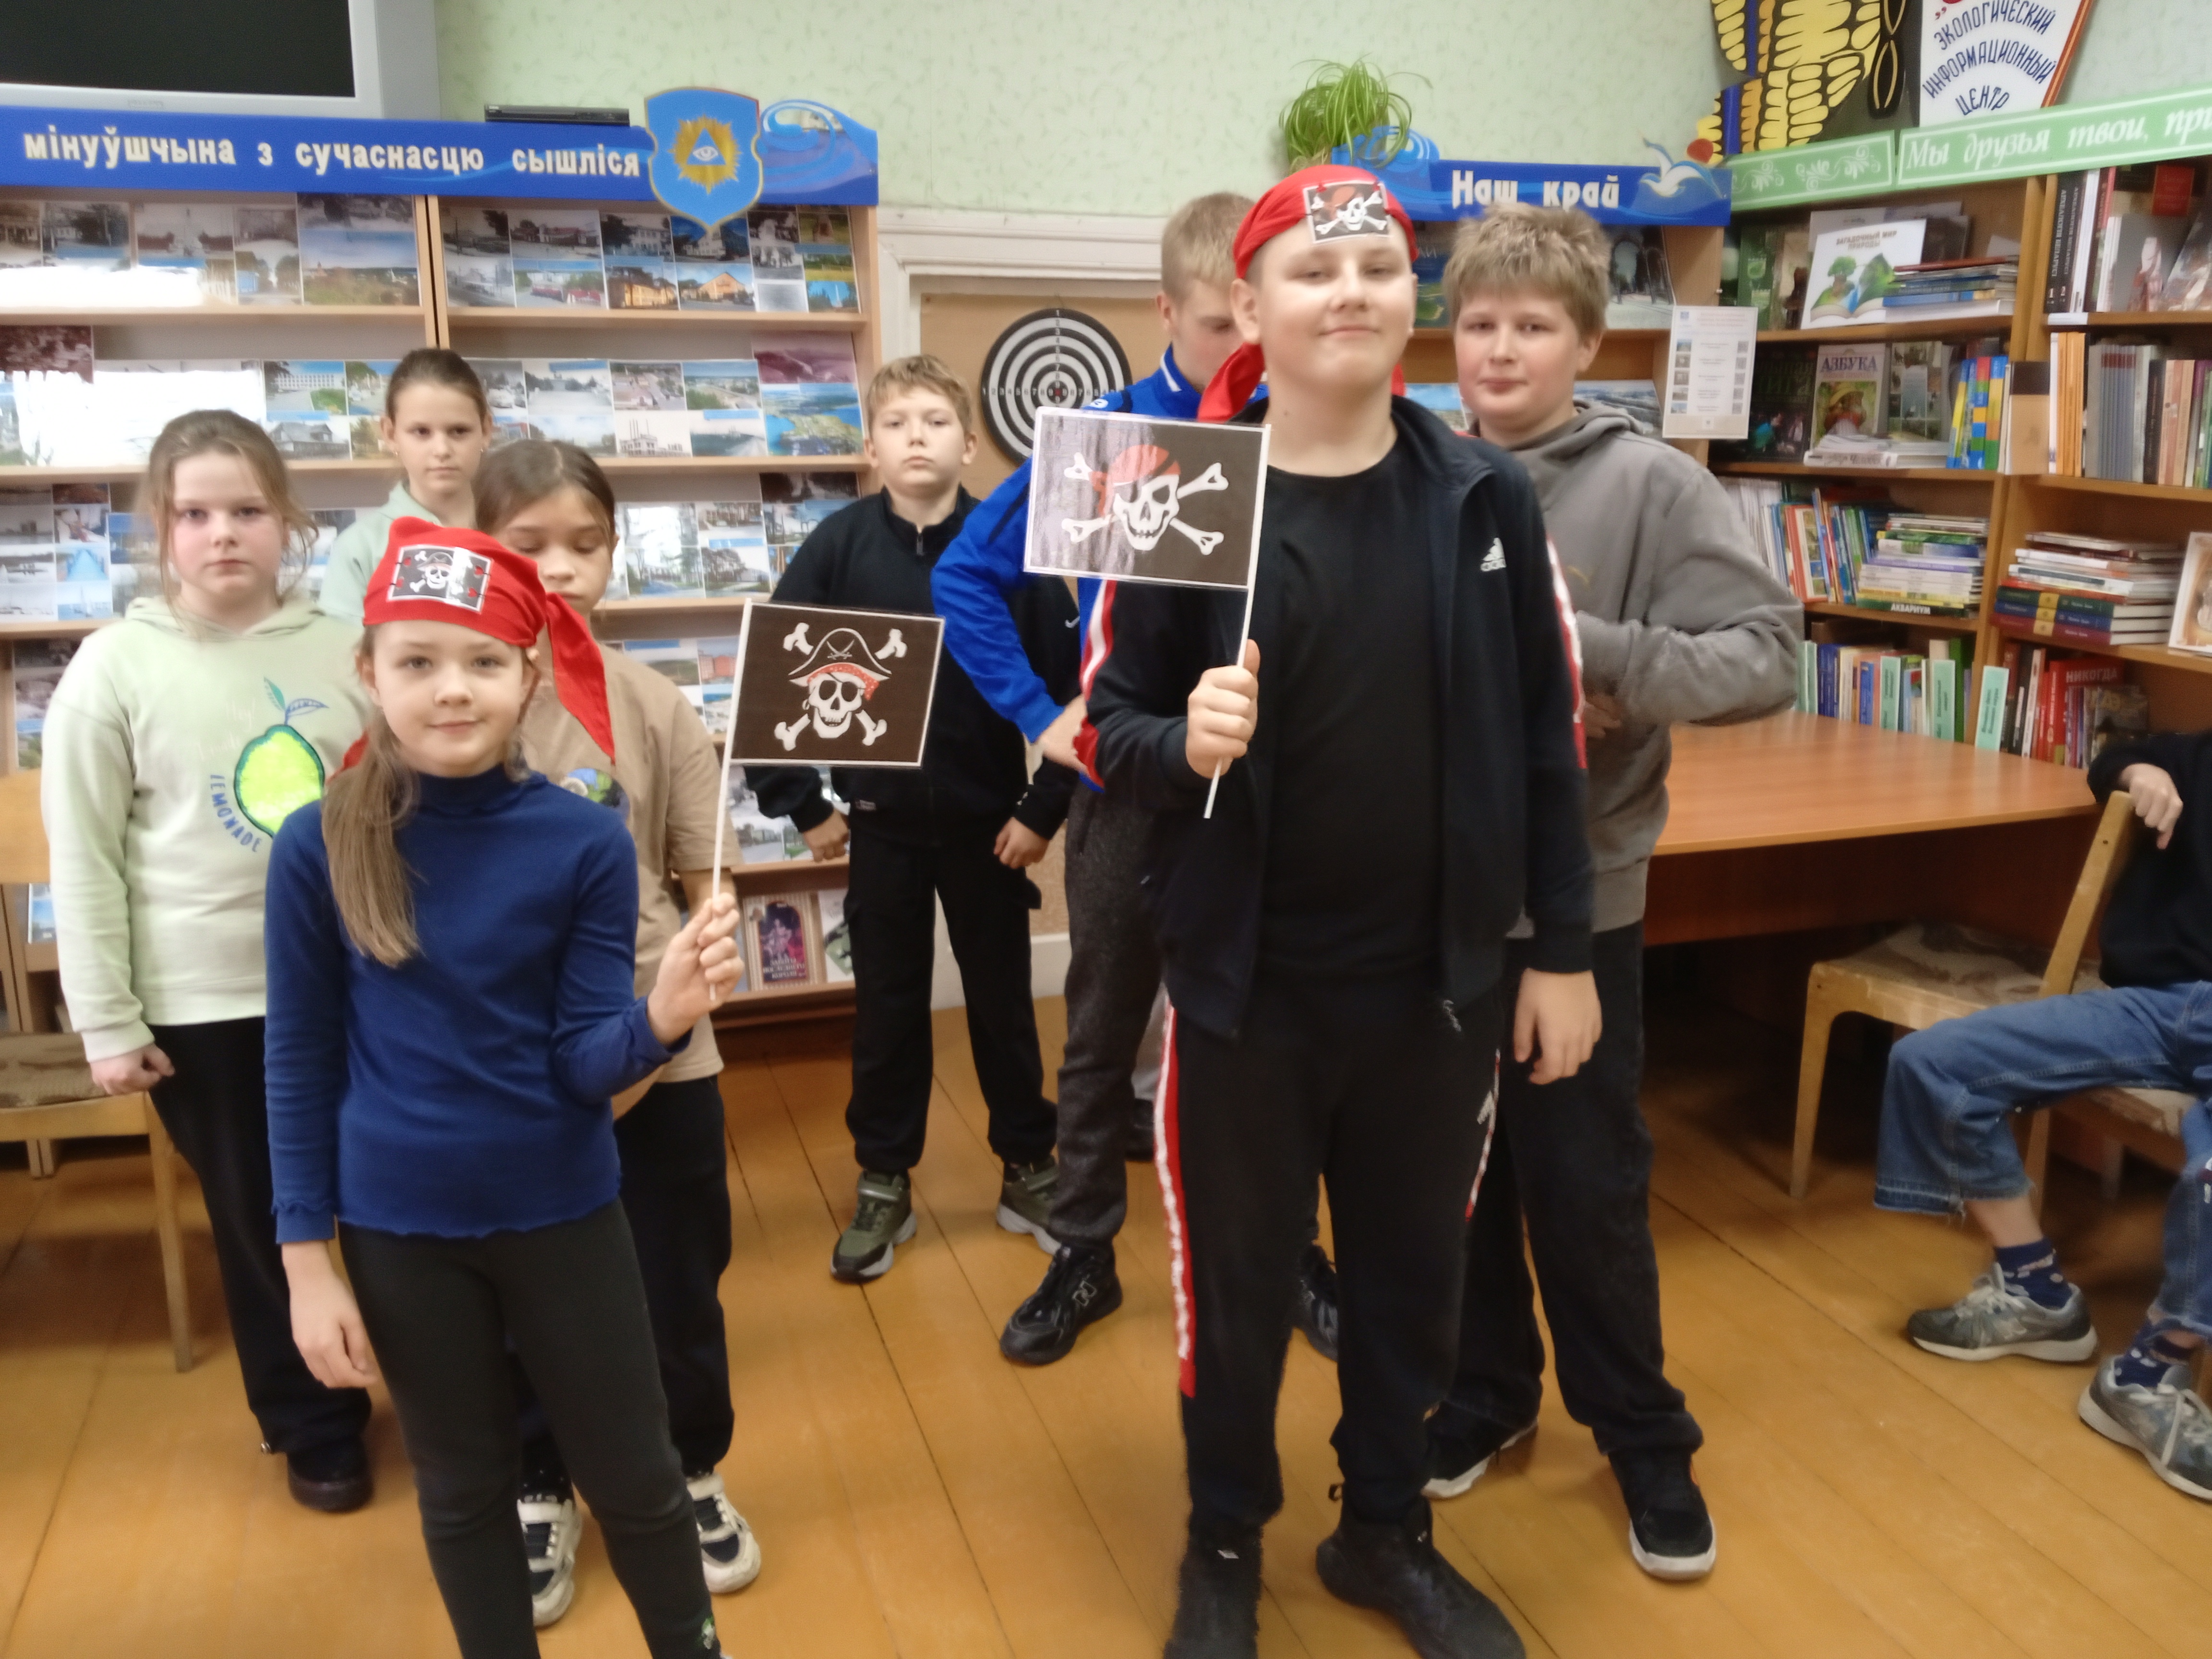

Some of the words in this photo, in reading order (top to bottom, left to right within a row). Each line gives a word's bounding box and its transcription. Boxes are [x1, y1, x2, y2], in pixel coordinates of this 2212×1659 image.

[1934, 0, 2056, 50] ЭКОЛОГИЧЕСКИЙ
[1922, 39, 2057, 98] ИНФОРМАЦИОННЫЙ
[1955, 85, 2010, 116] ЦЕНТР
[24, 124, 236, 169] мінуўшчына
[257, 142, 273, 166] з
[295, 142, 484, 175] сучаснасцю
[512, 144, 639, 177] сышліся
[1906, 140, 1949, 170] Мы
[1963, 129, 2051, 171] друзья
[2068, 116, 2149, 150] твои,
[1452, 169, 1518, 210] Наш
[1543, 174, 1620, 212] край
[1882, 230, 1897, 239] МИР
[1821, 355, 1878, 373] АЗБУКА
[1890, 602, 1931, 615] АКВАРИУМ
[2066, 668, 2117, 683] НИКОГДА
[210, 774, 263, 853] LEMONADE
